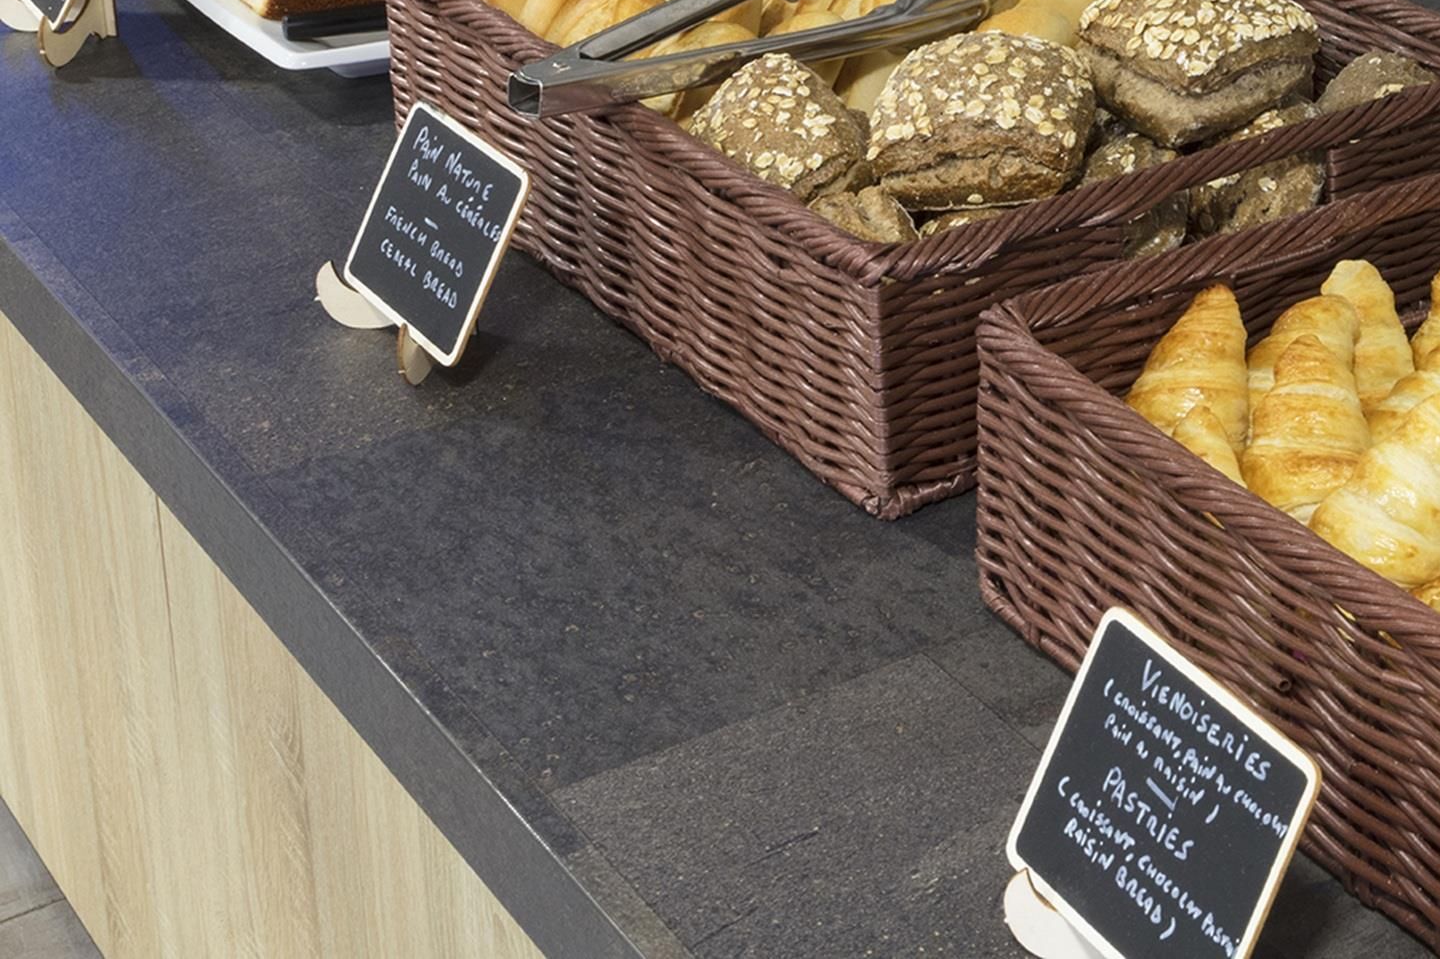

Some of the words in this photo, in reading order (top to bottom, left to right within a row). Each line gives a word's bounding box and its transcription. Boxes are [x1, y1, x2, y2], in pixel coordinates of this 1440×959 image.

[407, 158, 433, 191] PAIN
[412, 125, 444, 164] PAIN
[445, 151, 494, 202] NATURE
[380, 238, 417, 278] CEREAL
[423, 270, 458, 310] BREAD
[384, 205, 428, 247] FRENCH
[430, 240, 464, 278] BREAD
[1142, 658, 1272, 782] VIENOISERIES
[1102, 765, 1195, 861] PASTRIES
